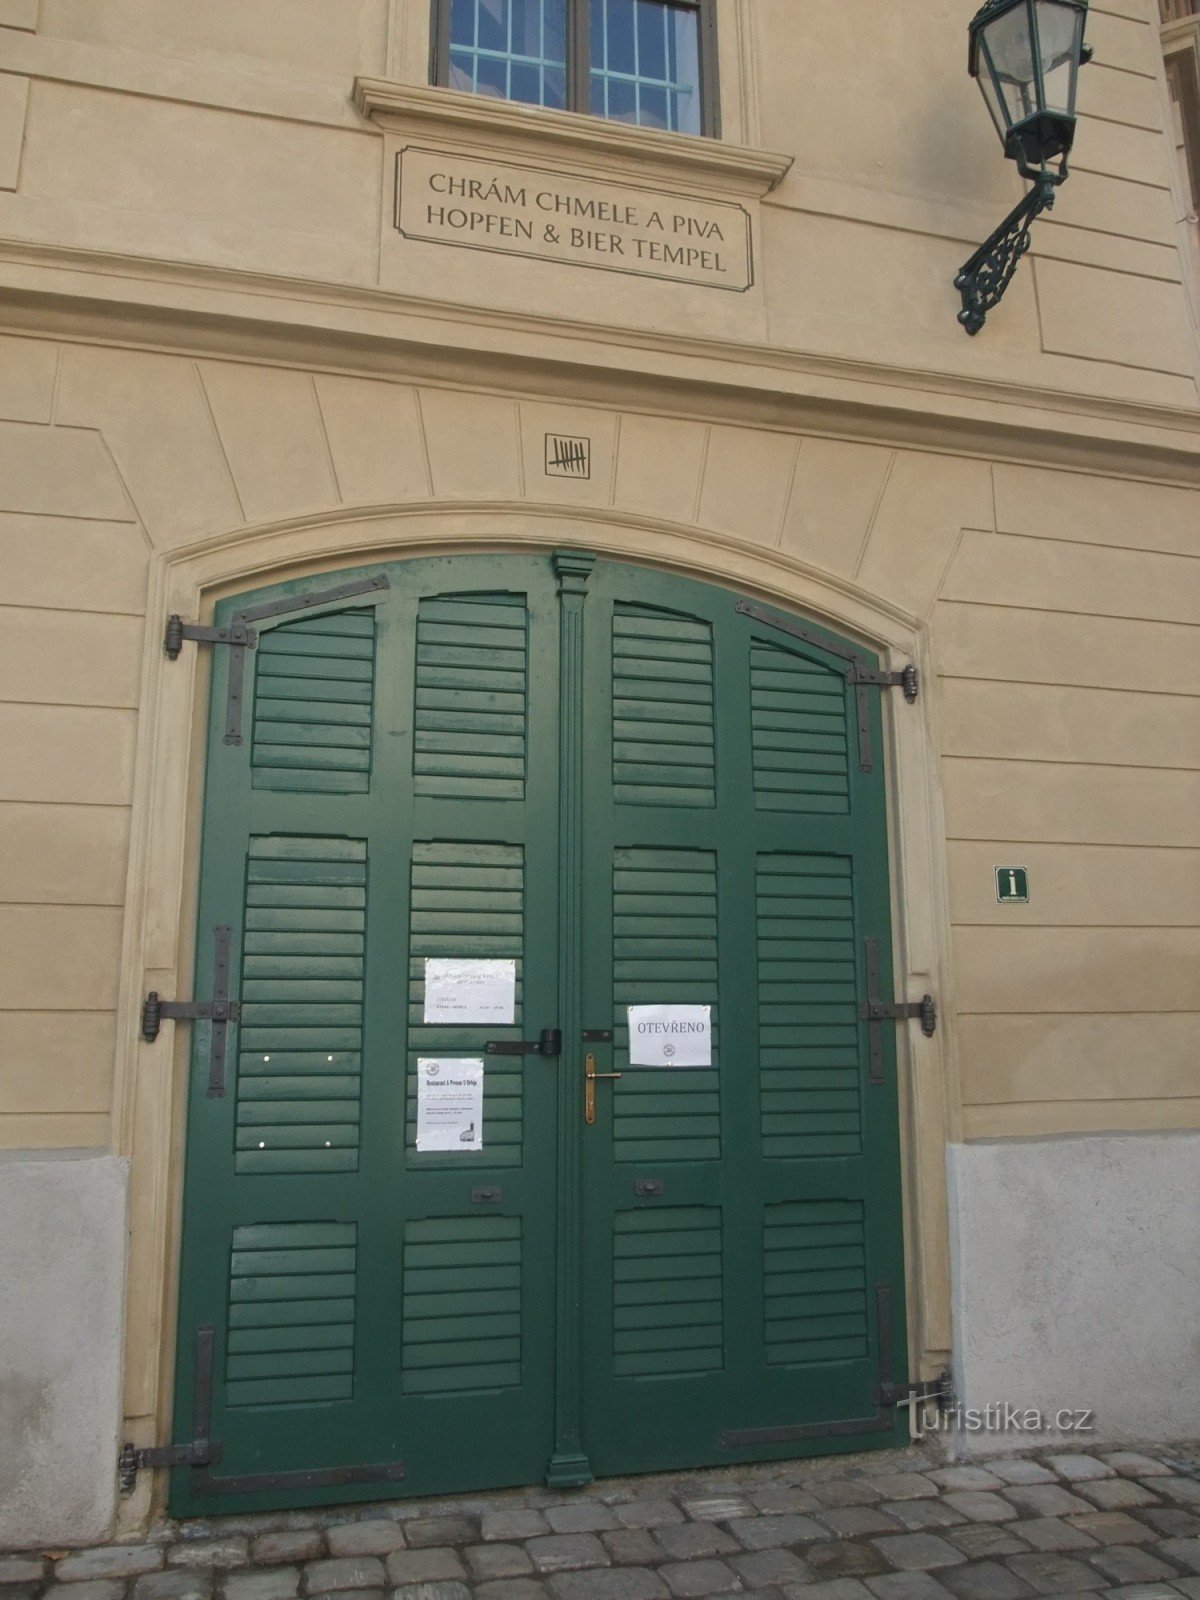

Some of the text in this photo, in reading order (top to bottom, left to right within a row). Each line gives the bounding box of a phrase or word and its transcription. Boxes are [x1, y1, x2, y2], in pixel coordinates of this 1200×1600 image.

[426, 205, 727, 272] HOPFEN & BIER TEMPEL
[429, 173, 725, 241] CHRÁM CHMELE A PIVA
[637, 1020, 705, 1034] OTEVŘENO
